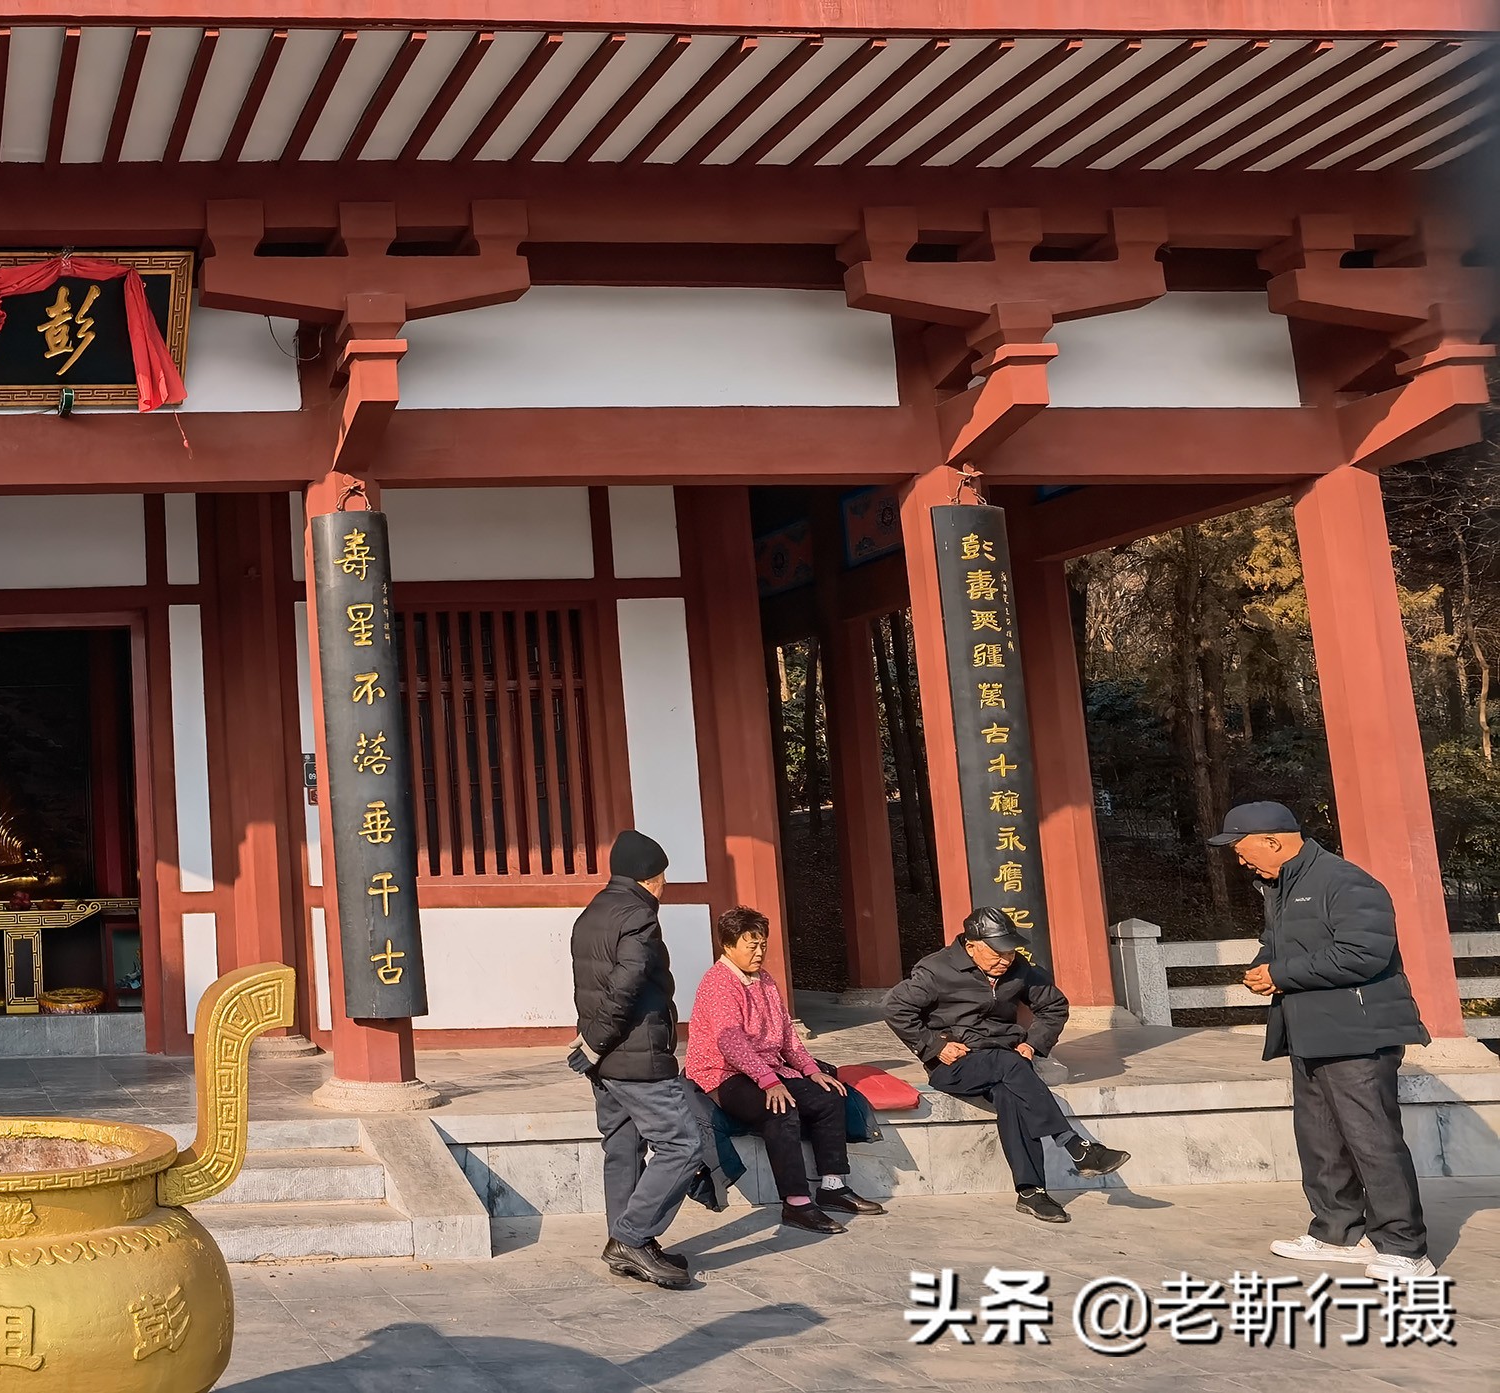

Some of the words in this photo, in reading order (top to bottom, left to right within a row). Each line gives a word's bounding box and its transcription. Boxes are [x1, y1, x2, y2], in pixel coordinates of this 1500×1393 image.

[334, 527, 406, 985] 壽星不落垂千古
